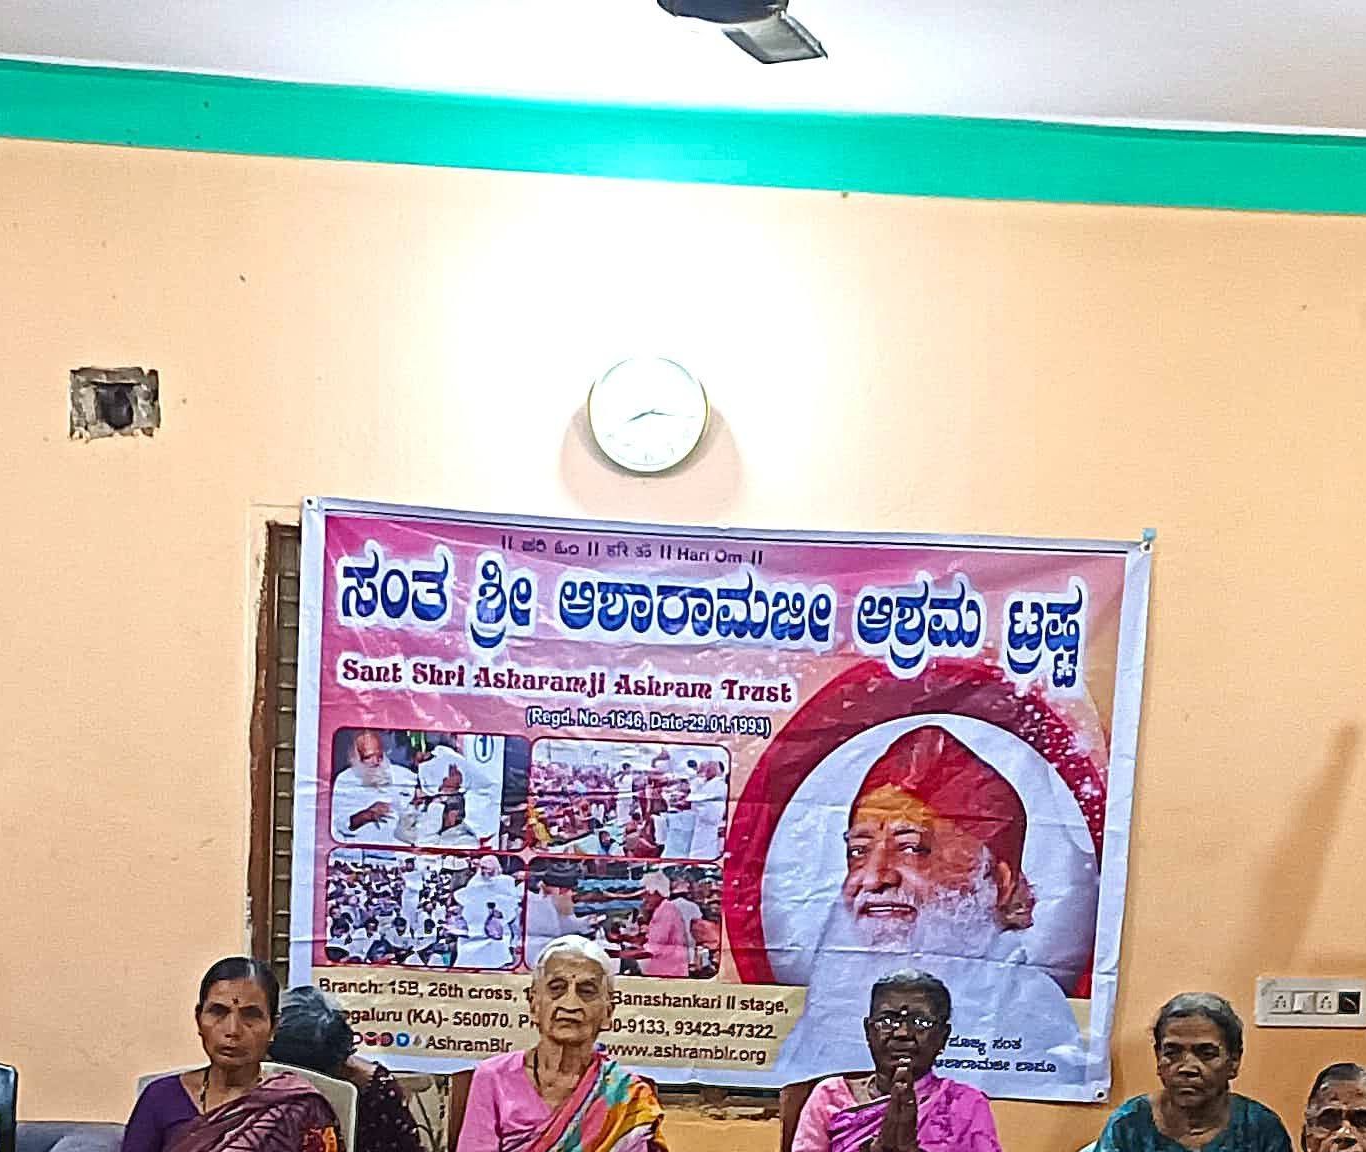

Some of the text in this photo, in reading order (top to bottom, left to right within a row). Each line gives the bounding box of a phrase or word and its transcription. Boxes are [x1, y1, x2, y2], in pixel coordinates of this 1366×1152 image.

[677, 546, 708, 562] Hari
[715, 549, 742, 564] Om
[341, 550, 450, 622] ಸಂತ
[470, 560, 532, 649] ಶ್ರೀ
[559, 572, 832, 643] ಆಶಾರಾಮಜೀ
[857, 580, 981, 669] ಆಶ್ರಮ
[342, 659, 792, 702] Sant Shri Asharamji Ashram Trust
[526, 707, 575, 728] (Regd.
[650, 714, 771, 736] Date-29.01.1993)
[319, 978, 383, 994] Branch:
[428, 982, 463, 998] 26th
[612, 990, 721, 1010] Banashankari
[740, 997, 789, 1015] stage,
[426, 1037, 514, 1053] AshramBlr
[607, 1043, 766, 1065] www.ashramblr.org
